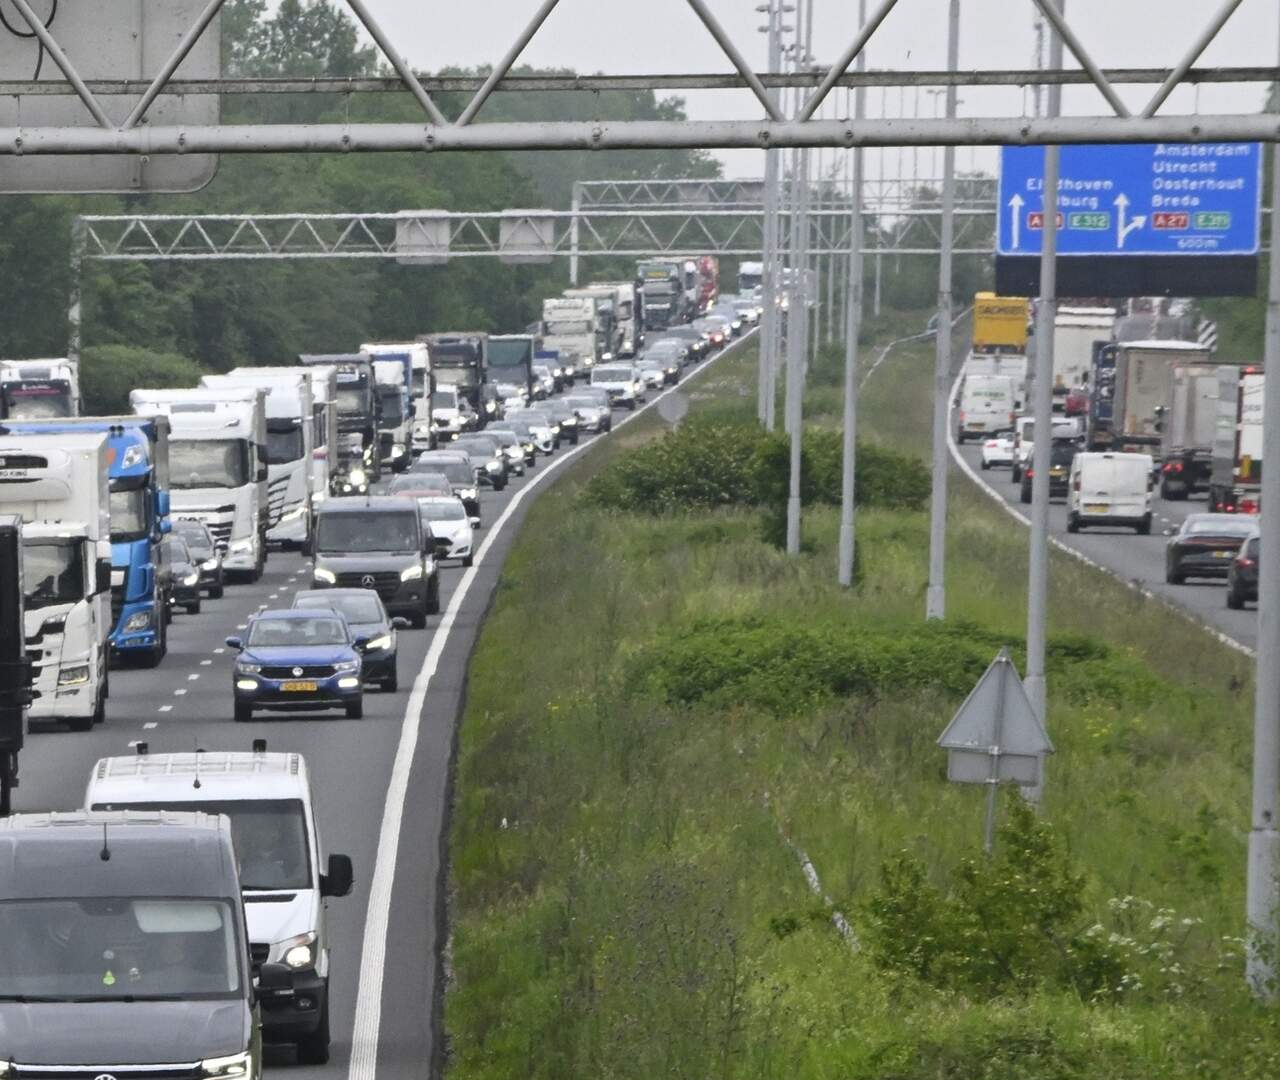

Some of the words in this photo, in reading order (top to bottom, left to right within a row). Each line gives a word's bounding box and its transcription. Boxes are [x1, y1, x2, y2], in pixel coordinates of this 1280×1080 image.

[1153, 143, 1249, 156] Amsterdam
[1152, 161, 1216, 173] Utrecht
[1152, 178, 1244, 190] Oosterhout
[1152, 194, 1200, 207] Breda
